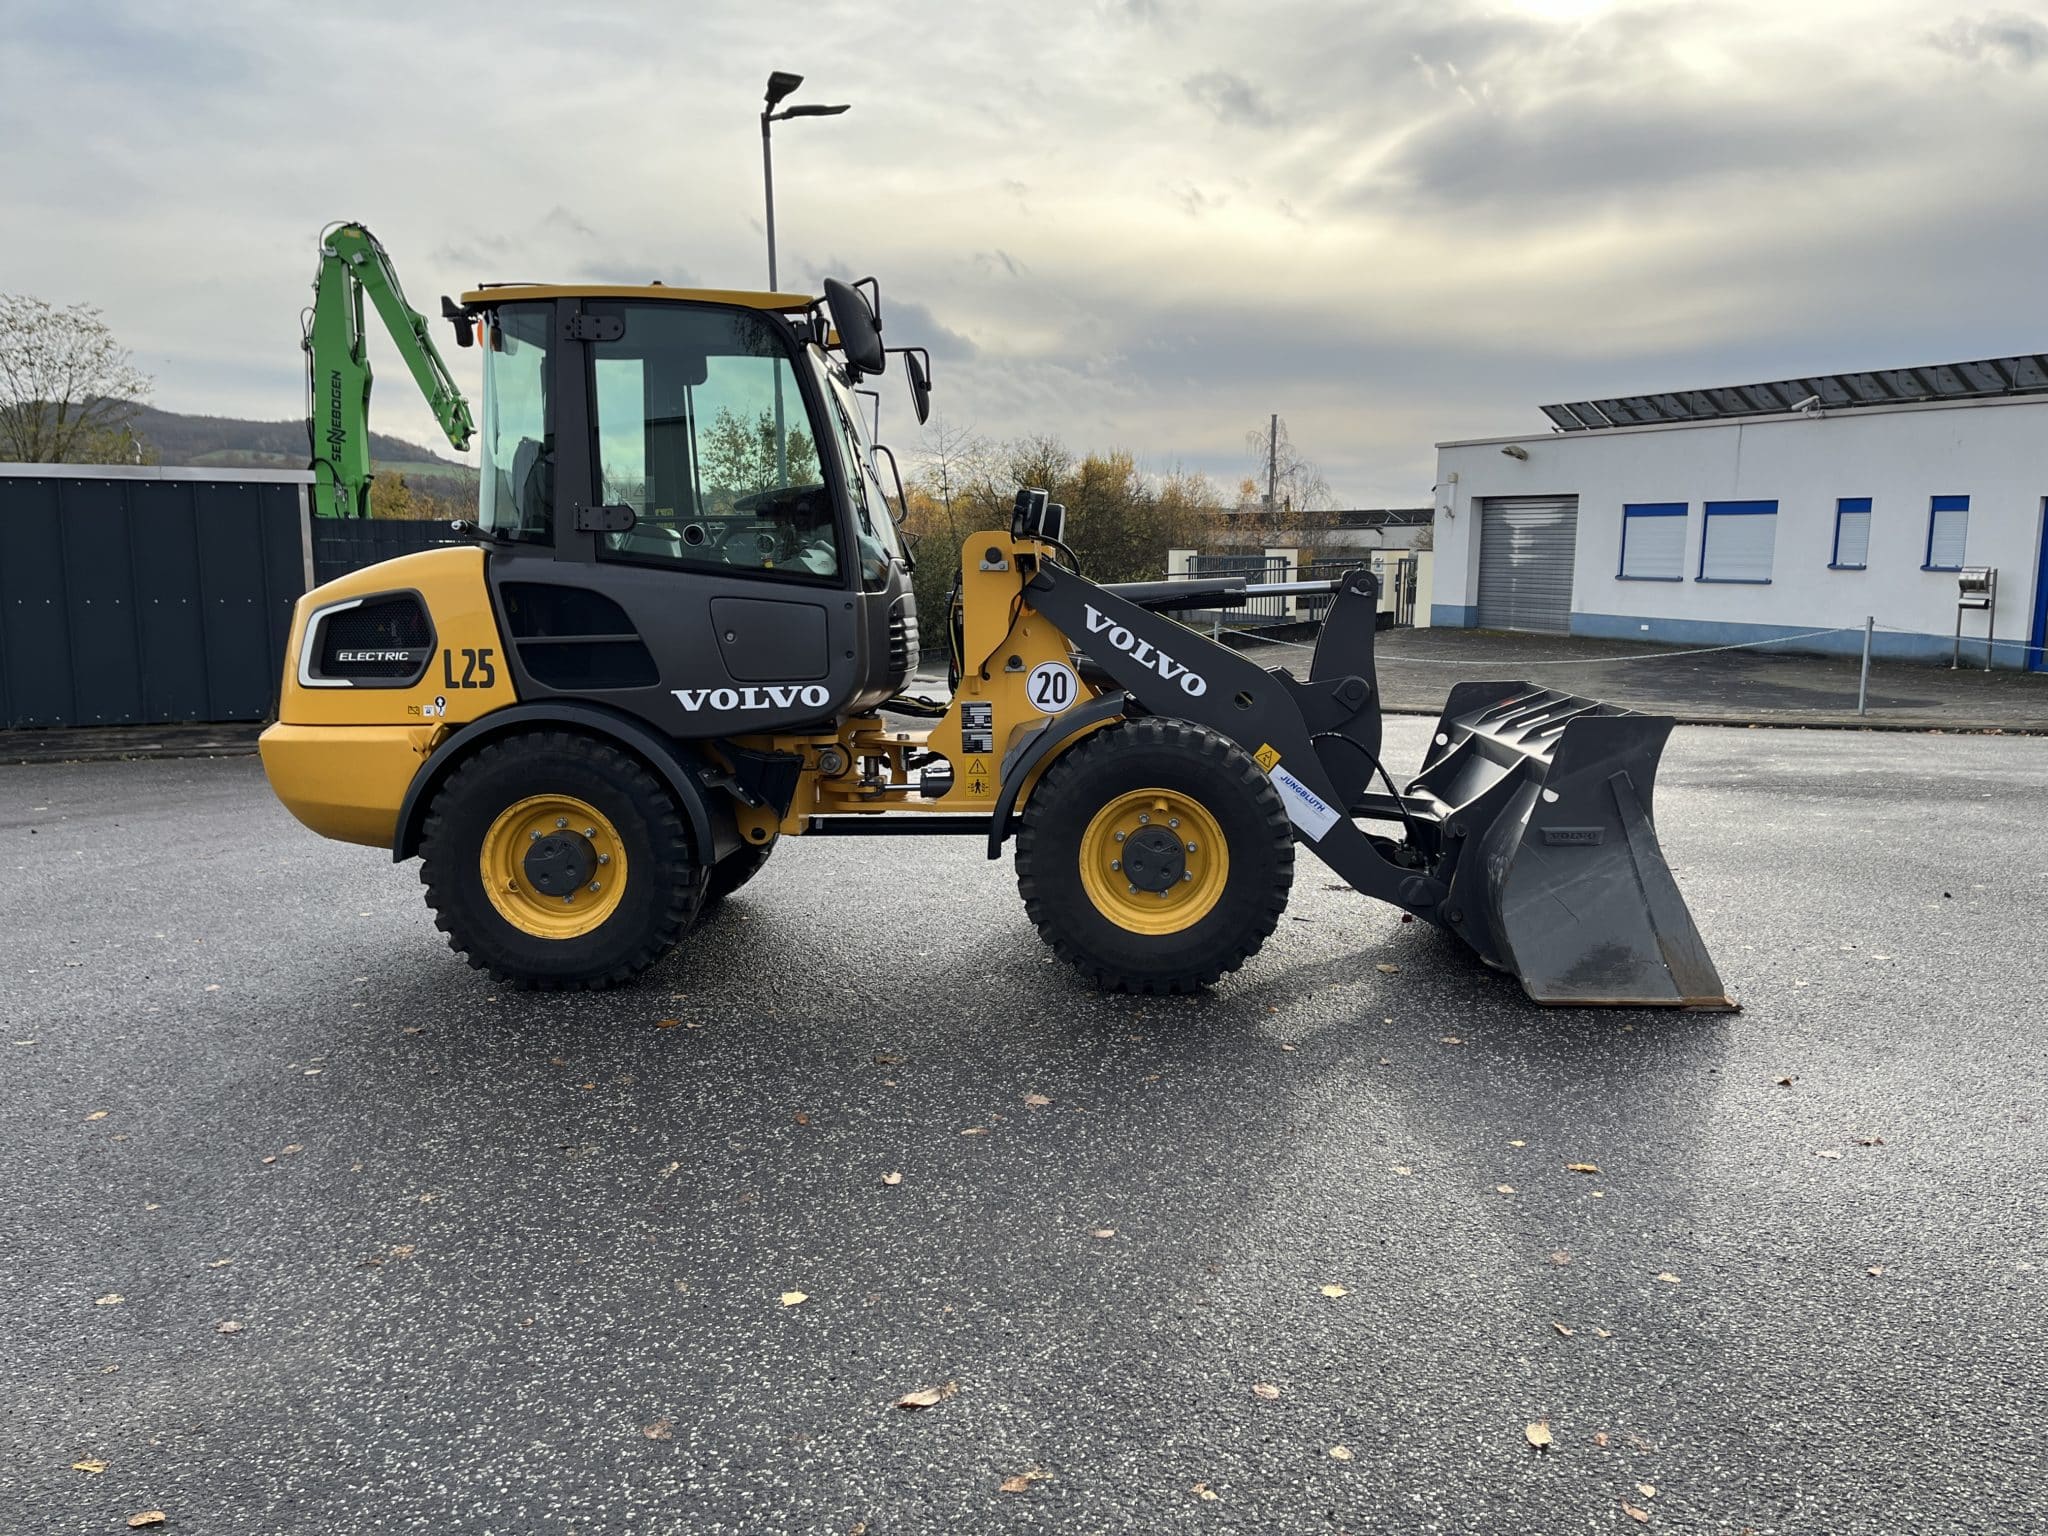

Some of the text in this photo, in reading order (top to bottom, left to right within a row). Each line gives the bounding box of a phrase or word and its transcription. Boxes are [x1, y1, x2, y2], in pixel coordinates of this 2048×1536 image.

[339, 652, 409, 661] ELECTRIC
[1084, 604, 1207, 697] VOLVO
[444, 649, 495, 688] L25
[671, 685, 830, 712] VOLVO
[1036, 671, 1067, 703] 20
[1281, 776, 1326, 812] JUNGBLUTH
